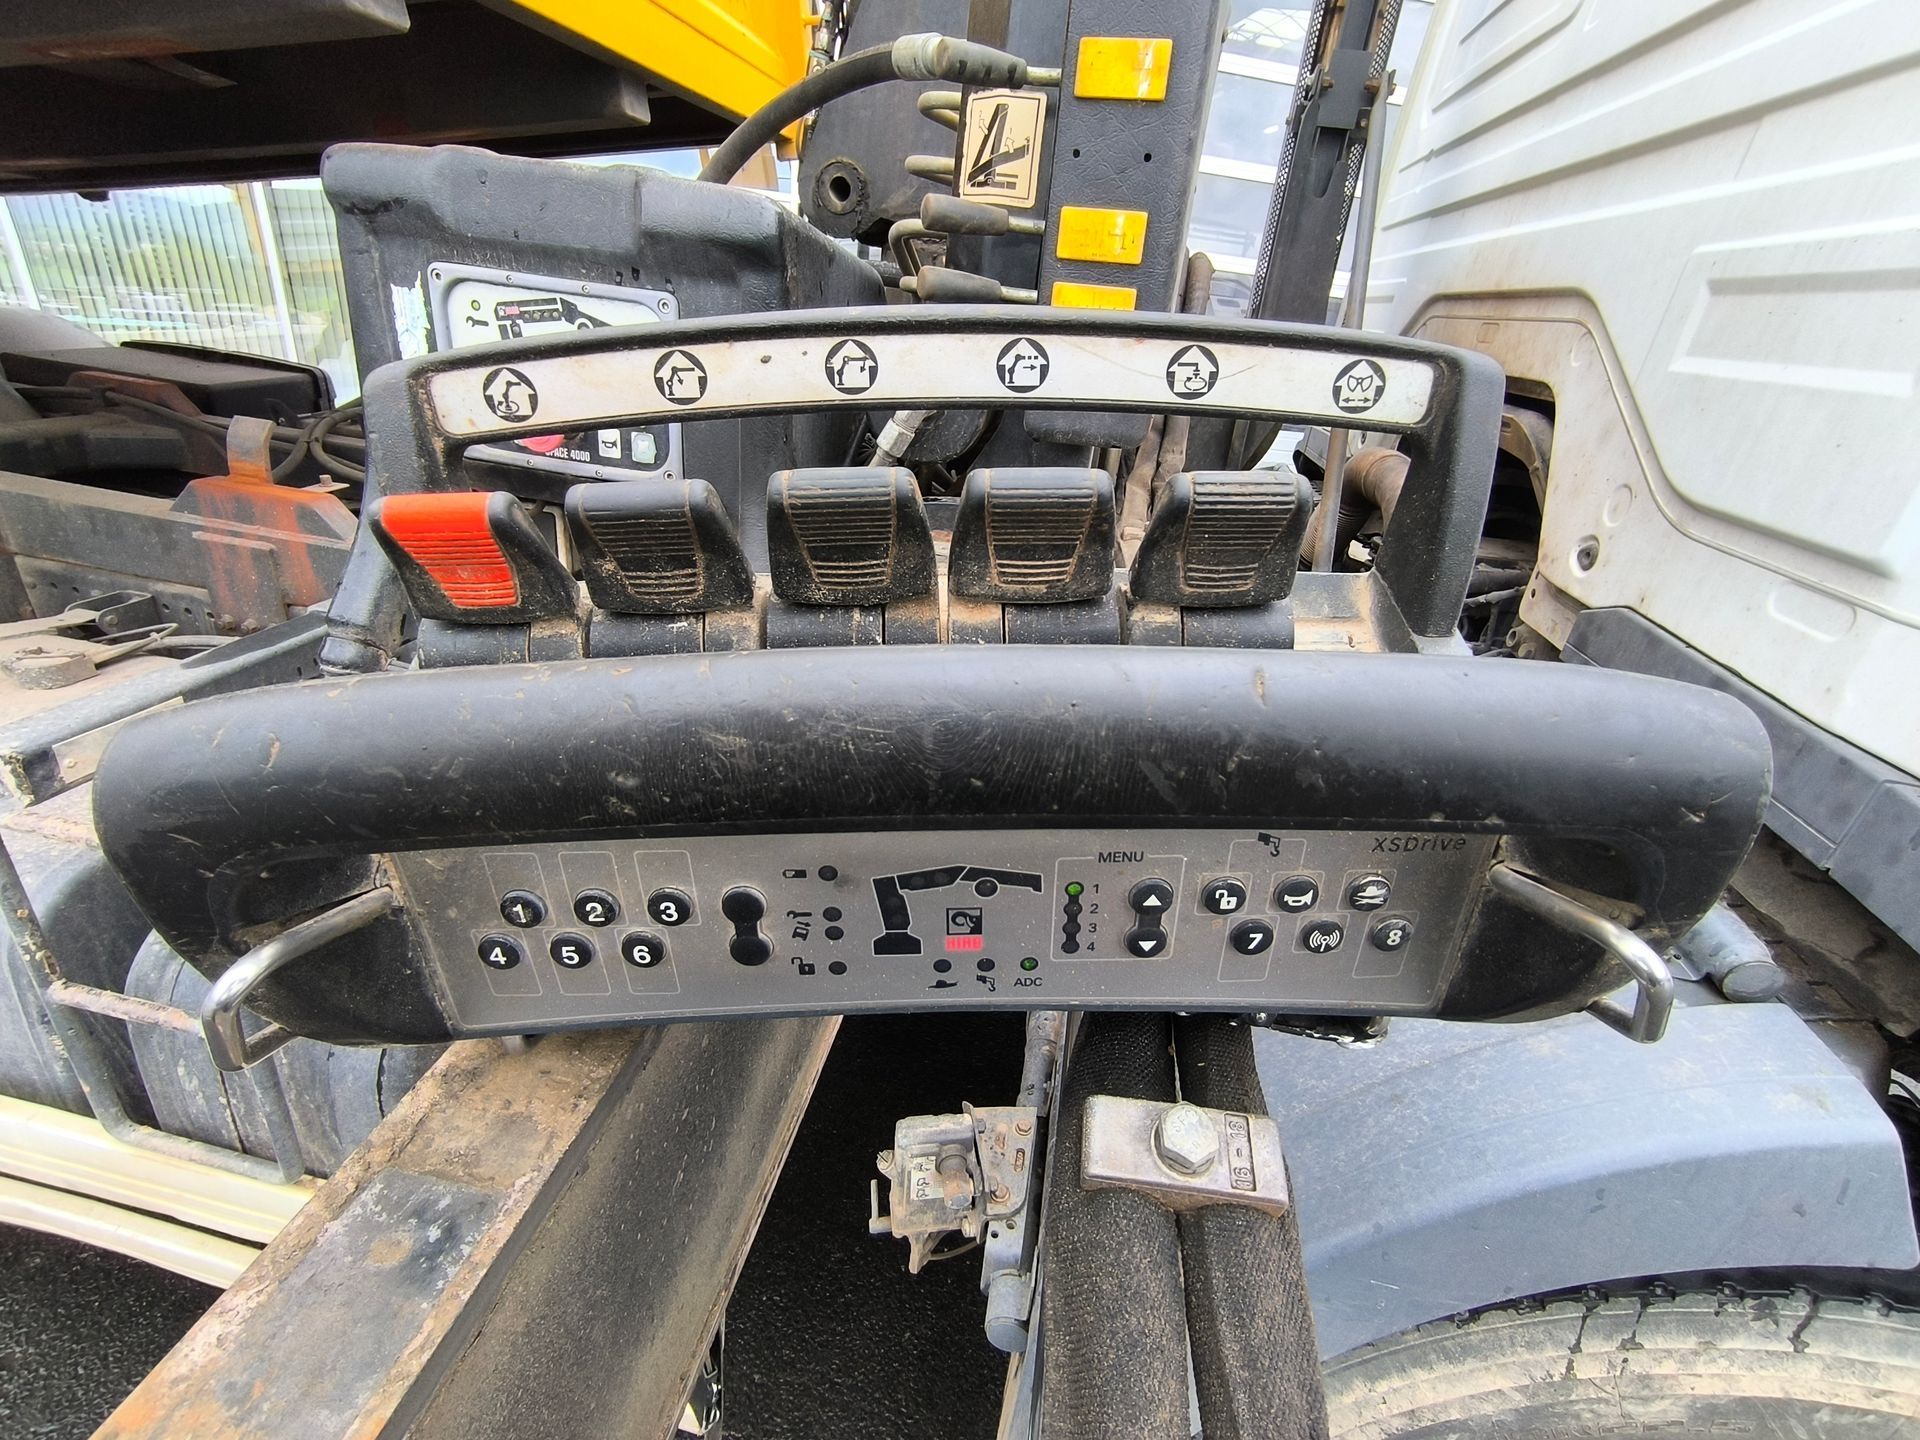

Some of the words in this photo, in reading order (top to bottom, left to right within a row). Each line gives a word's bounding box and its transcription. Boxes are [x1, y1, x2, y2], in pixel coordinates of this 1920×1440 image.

[570, 450, 590, 461] 4000
[1371, 836, 1466, 853] XSDrive
[1098, 851, 1144, 864] MENU
[1092, 883, 1100, 895] 1
[511, 904, 527, 923] 1
[585, 902, 606, 922] 2
[659, 901, 679, 922] 3
[1090, 903, 1099, 914] 2
[1088, 922, 1098, 933] 3
[1247, 933, 1263, 949] 7
[1386, 929, 1402, 945] 8
[1086, 941, 1096, 952] 4
[489, 946, 507, 965] 4
[561, 946, 580, 965] 5
[632, 945, 652, 964] 6
[1013, 977, 1043, 987] ADC
[1228, 1120, 1247, 1139] 18
[1233, 1166, 1252, 1187] 16
